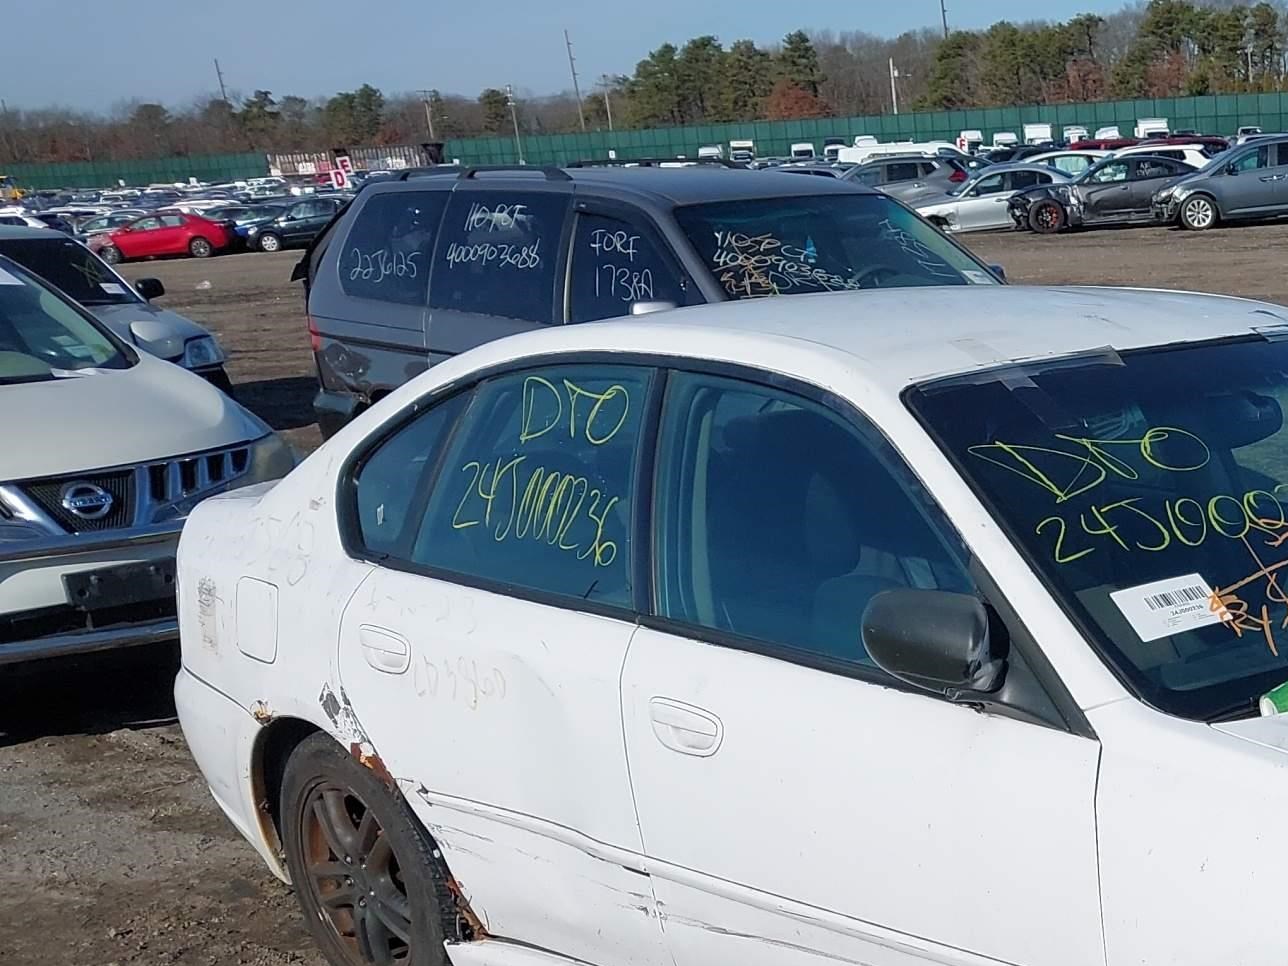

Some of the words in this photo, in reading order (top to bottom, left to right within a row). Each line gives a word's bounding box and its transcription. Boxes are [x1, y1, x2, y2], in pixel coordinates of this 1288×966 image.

[334, 172, 345, 187] D
[518, 376, 630, 444] DTO
[966, 426, 1211, 504] DTO
[451, 456, 619, 567] 24J000236
